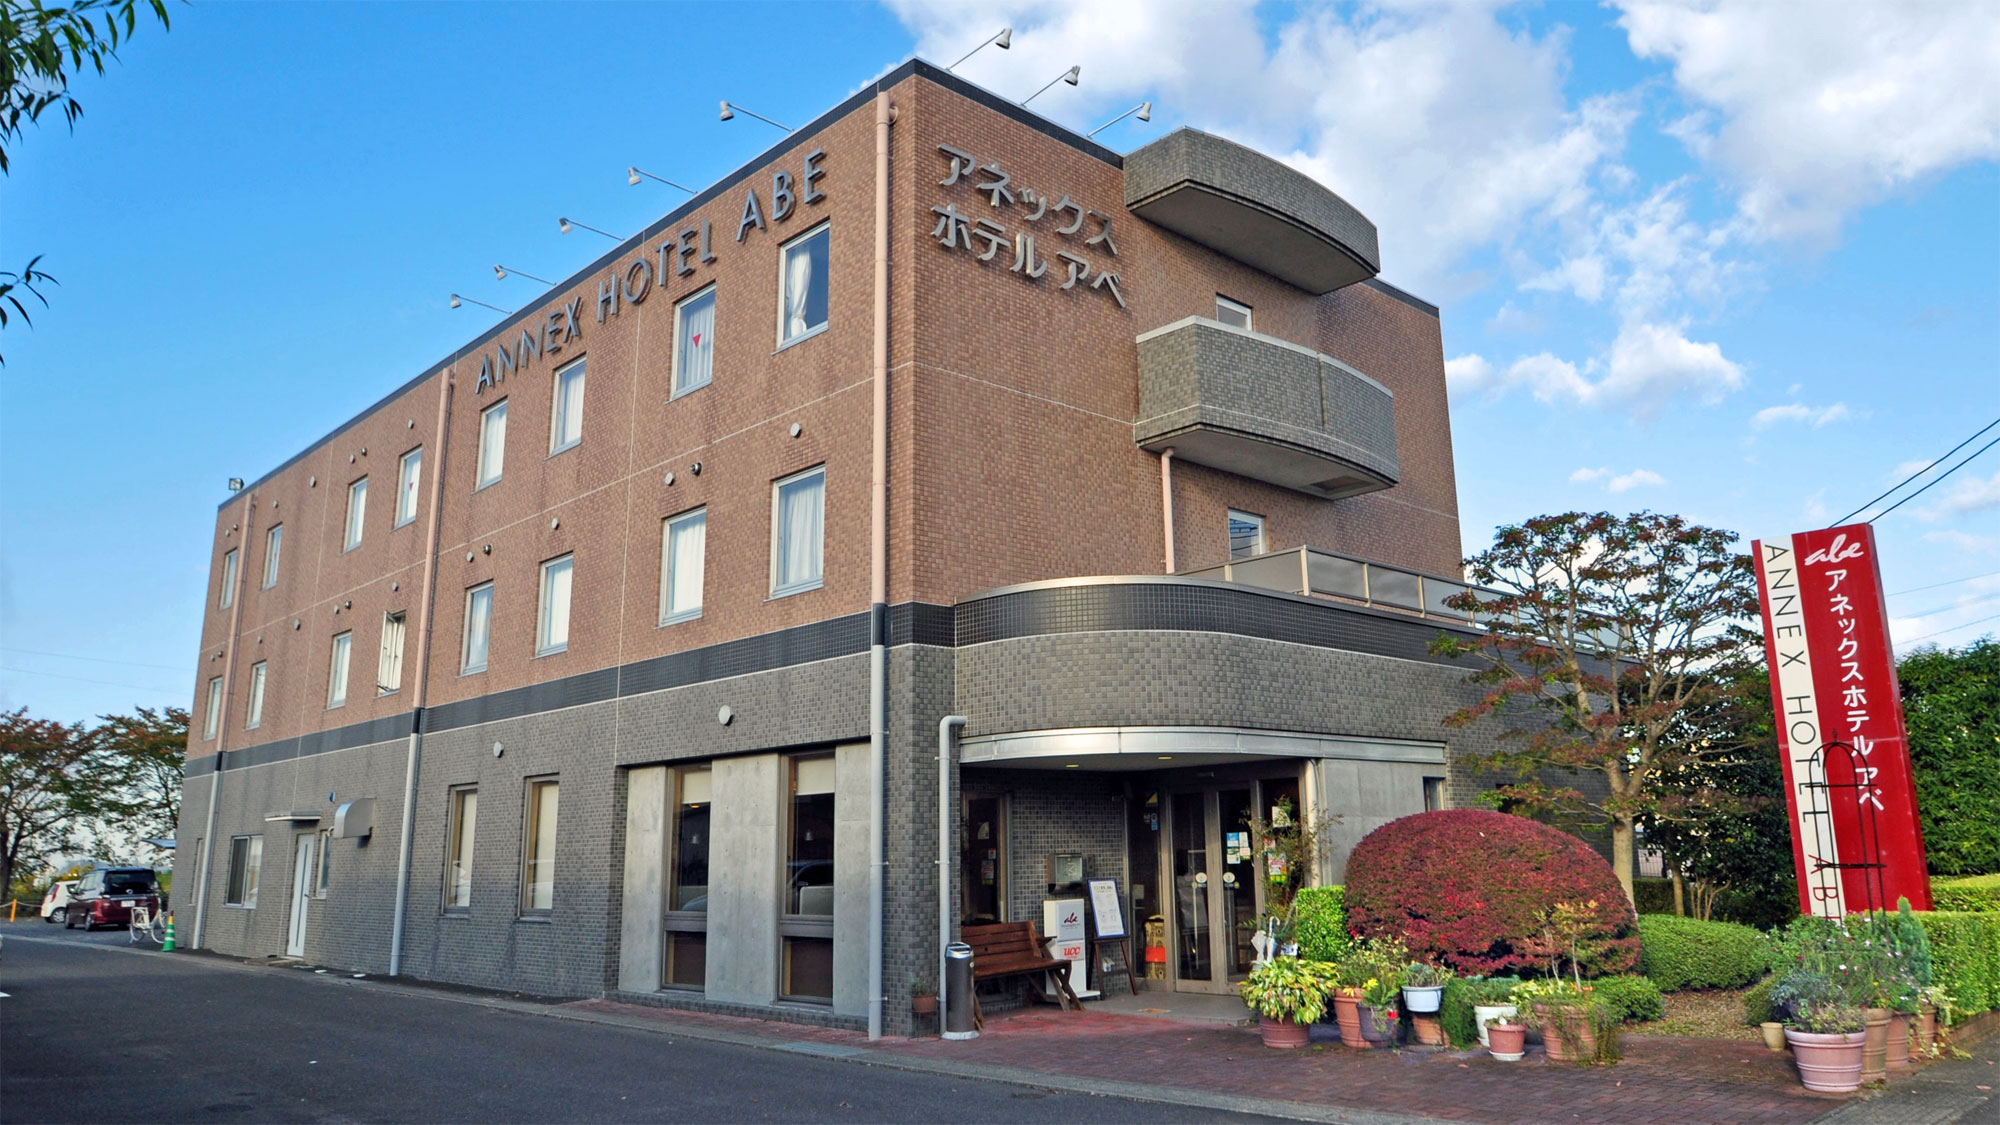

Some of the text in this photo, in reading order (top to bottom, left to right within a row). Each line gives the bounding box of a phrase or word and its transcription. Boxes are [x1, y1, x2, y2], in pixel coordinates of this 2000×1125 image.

[475, 147, 828, 395] ANNEX HOTEL ABE
[937, 142, 1118, 255] アネックス
[1804, 533, 1864, 566] abe
[1764, 543, 1807, 668] ANNEX
[1786, 694, 1829, 823] HOTEL
